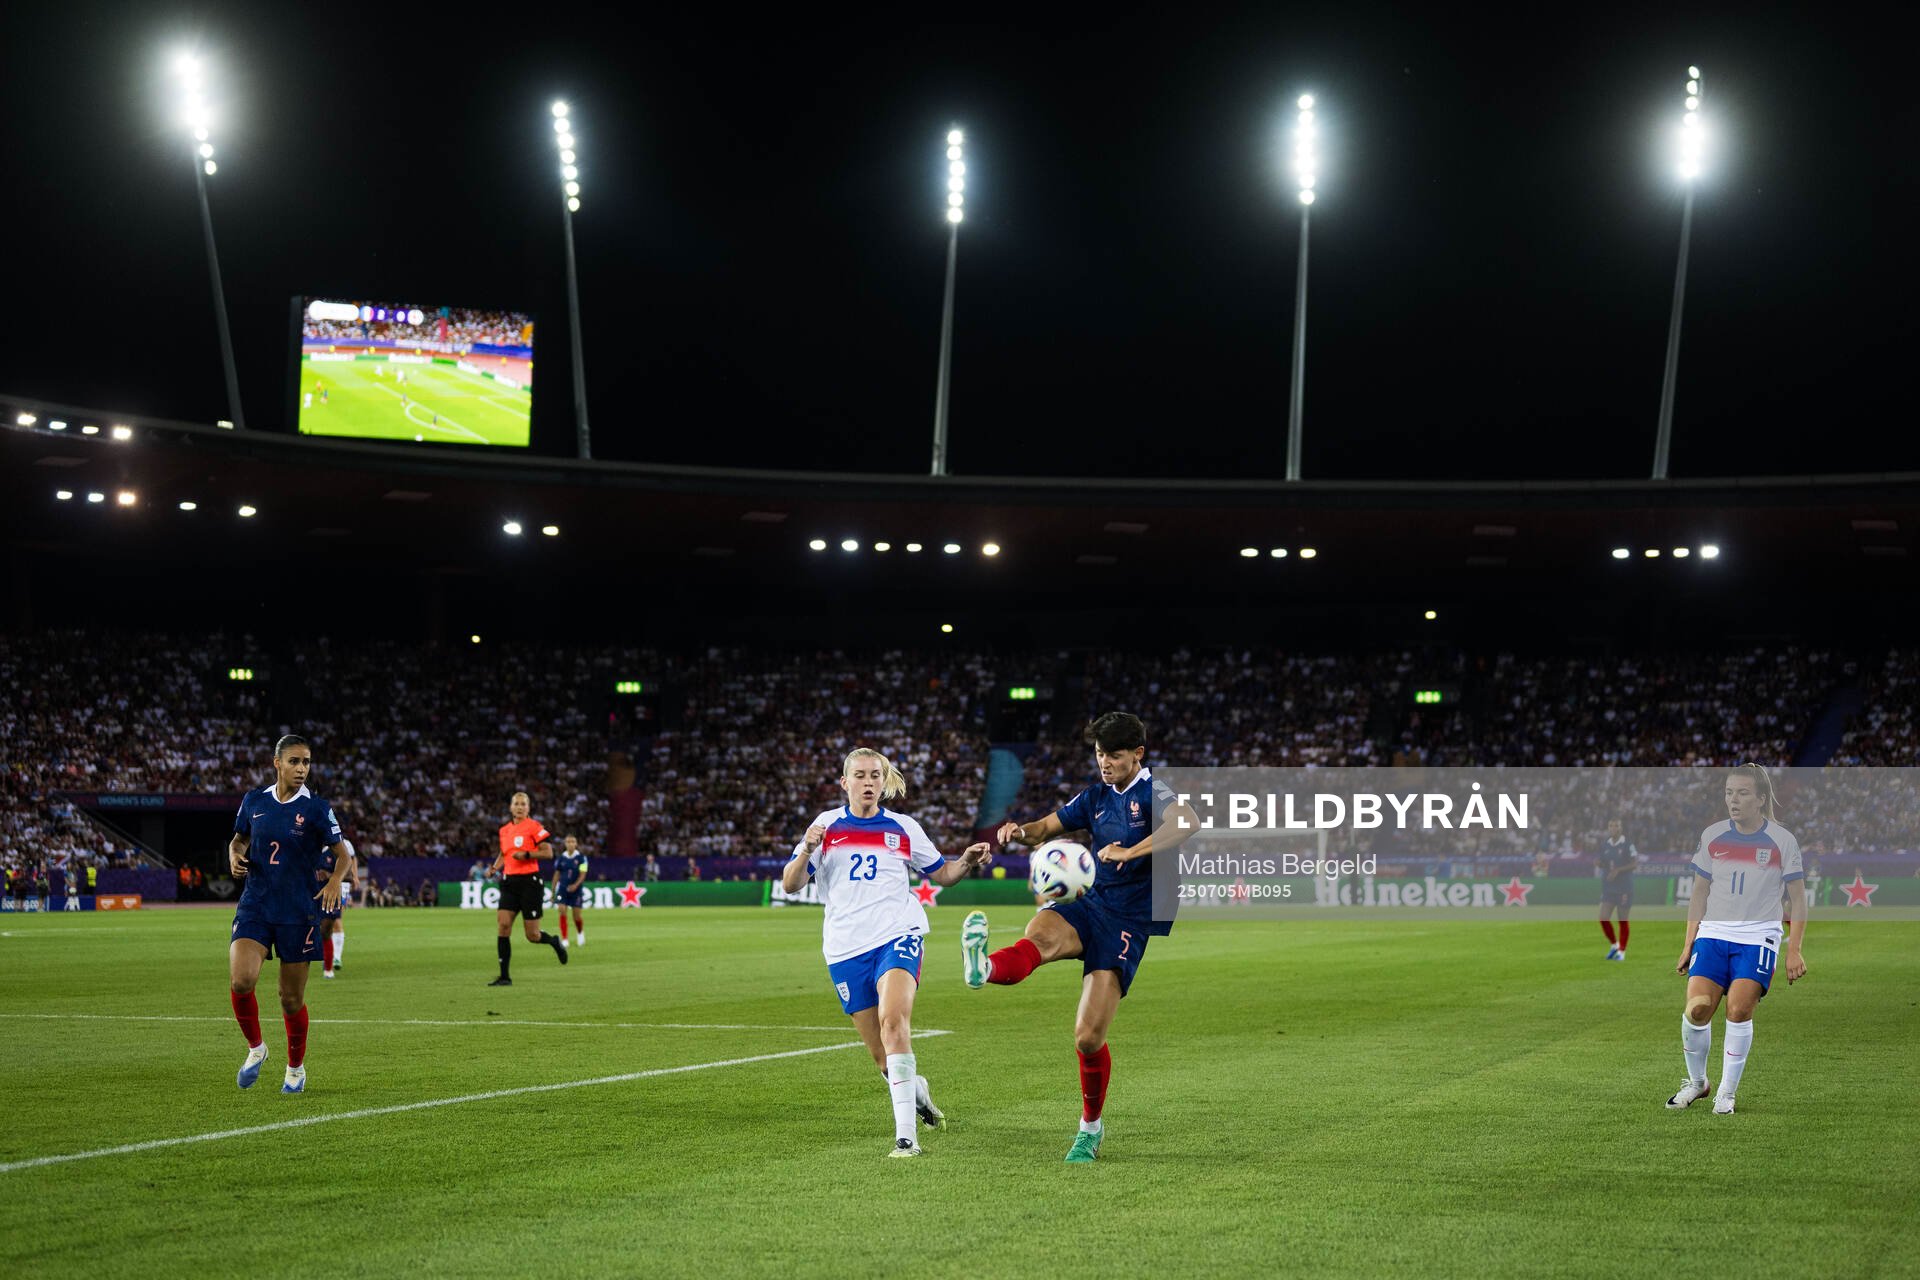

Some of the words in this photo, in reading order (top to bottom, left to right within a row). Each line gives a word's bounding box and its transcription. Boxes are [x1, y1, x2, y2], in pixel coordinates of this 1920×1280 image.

[269, 841, 280, 865] 2
[849, 853, 878, 881] 23
[1731, 870, 1745, 896] 11
[893, 935, 920, 957] 23
[1120, 930, 1132, 954] 5
[1758, 946, 1771, 970] 11
